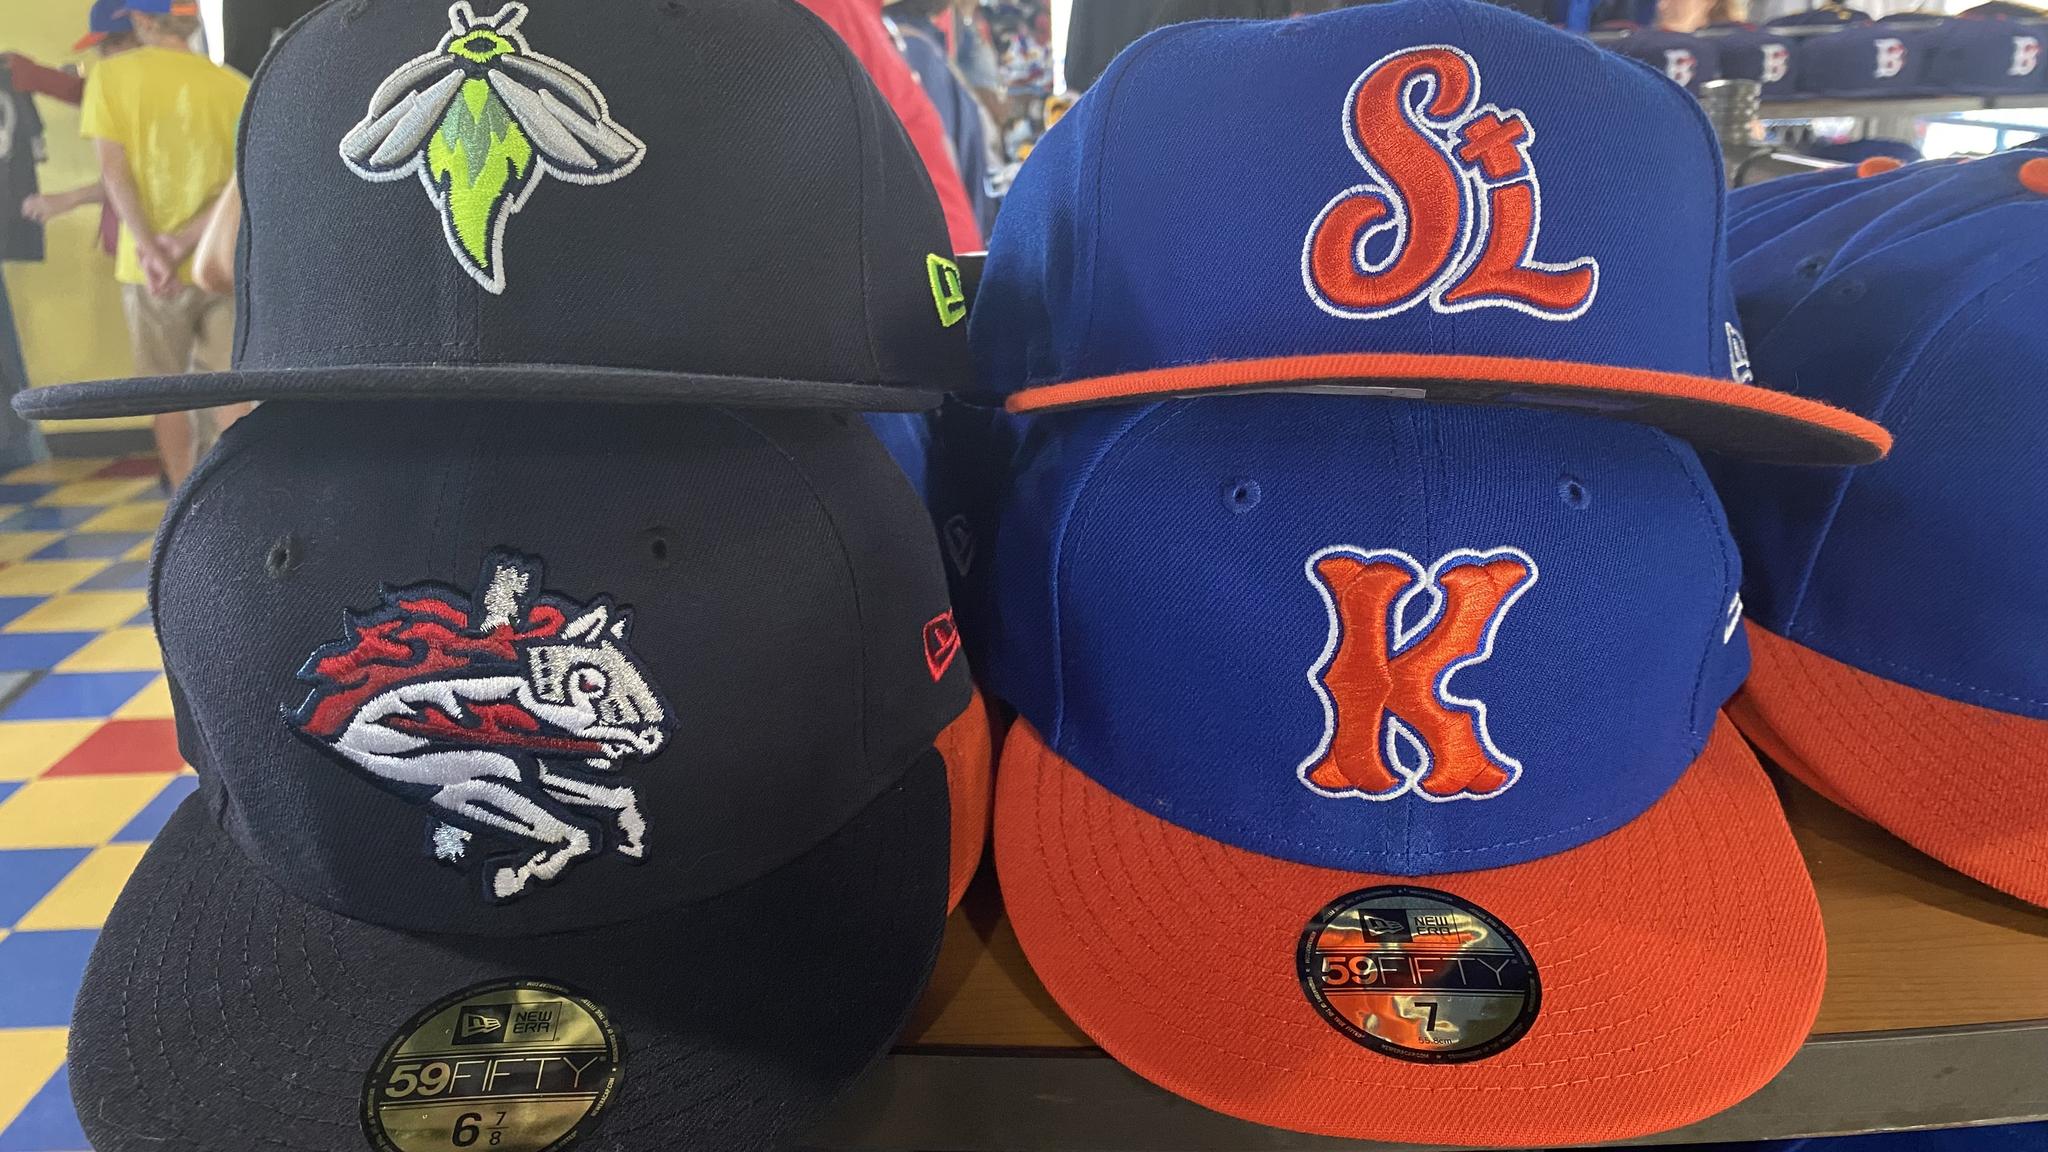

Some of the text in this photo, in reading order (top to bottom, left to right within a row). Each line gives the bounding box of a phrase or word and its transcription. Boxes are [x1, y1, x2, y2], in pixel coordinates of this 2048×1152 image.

[1664, 49, 1697, 87] B
[1762, 43, 1790, 82] B
[1874, 38, 1905, 78] B
[2008, 36, 2041, 76] B
[1296, 545, 1539, 803] K
[1413, 916, 1449, 926] NEW
[1416, 926, 1451, 937] ERA
[1321, 955, 1511, 986] 59FIFTY
[512, 1022, 550, 1034] ERA
[515, 1010, 553, 1022] NEW
[1414, 1002, 1438, 1032] 7
[384, 1056, 599, 1098] 59FIFTY
[452, 1111, 483, 1148] 6
